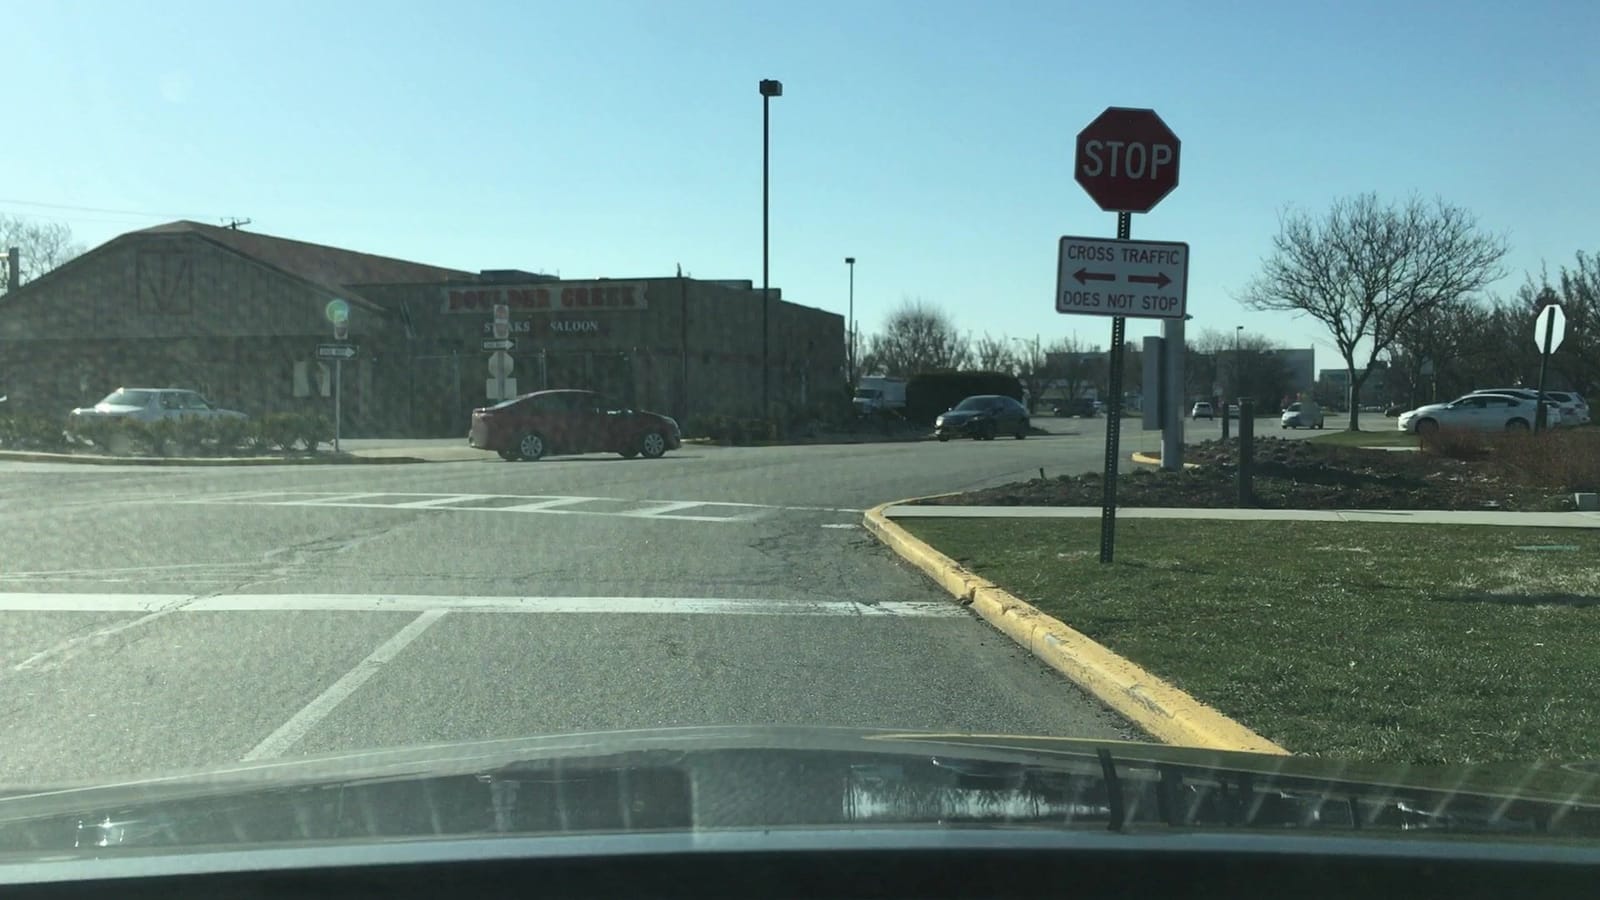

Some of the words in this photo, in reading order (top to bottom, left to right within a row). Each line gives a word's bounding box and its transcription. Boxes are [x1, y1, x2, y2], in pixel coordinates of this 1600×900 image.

[1083, 140, 1172, 179] STOP
[1068, 245, 1114, 261] CROSS
[1122, 248, 1179, 265] TRAFFIC
[1063, 291, 1100, 306] DOES
[1107, 294, 1135, 309] NOT
[1142, 295, 1178, 311] STOP
[484, 321, 530, 332] STAKS
[550, 321, 598, 331] SALOON
